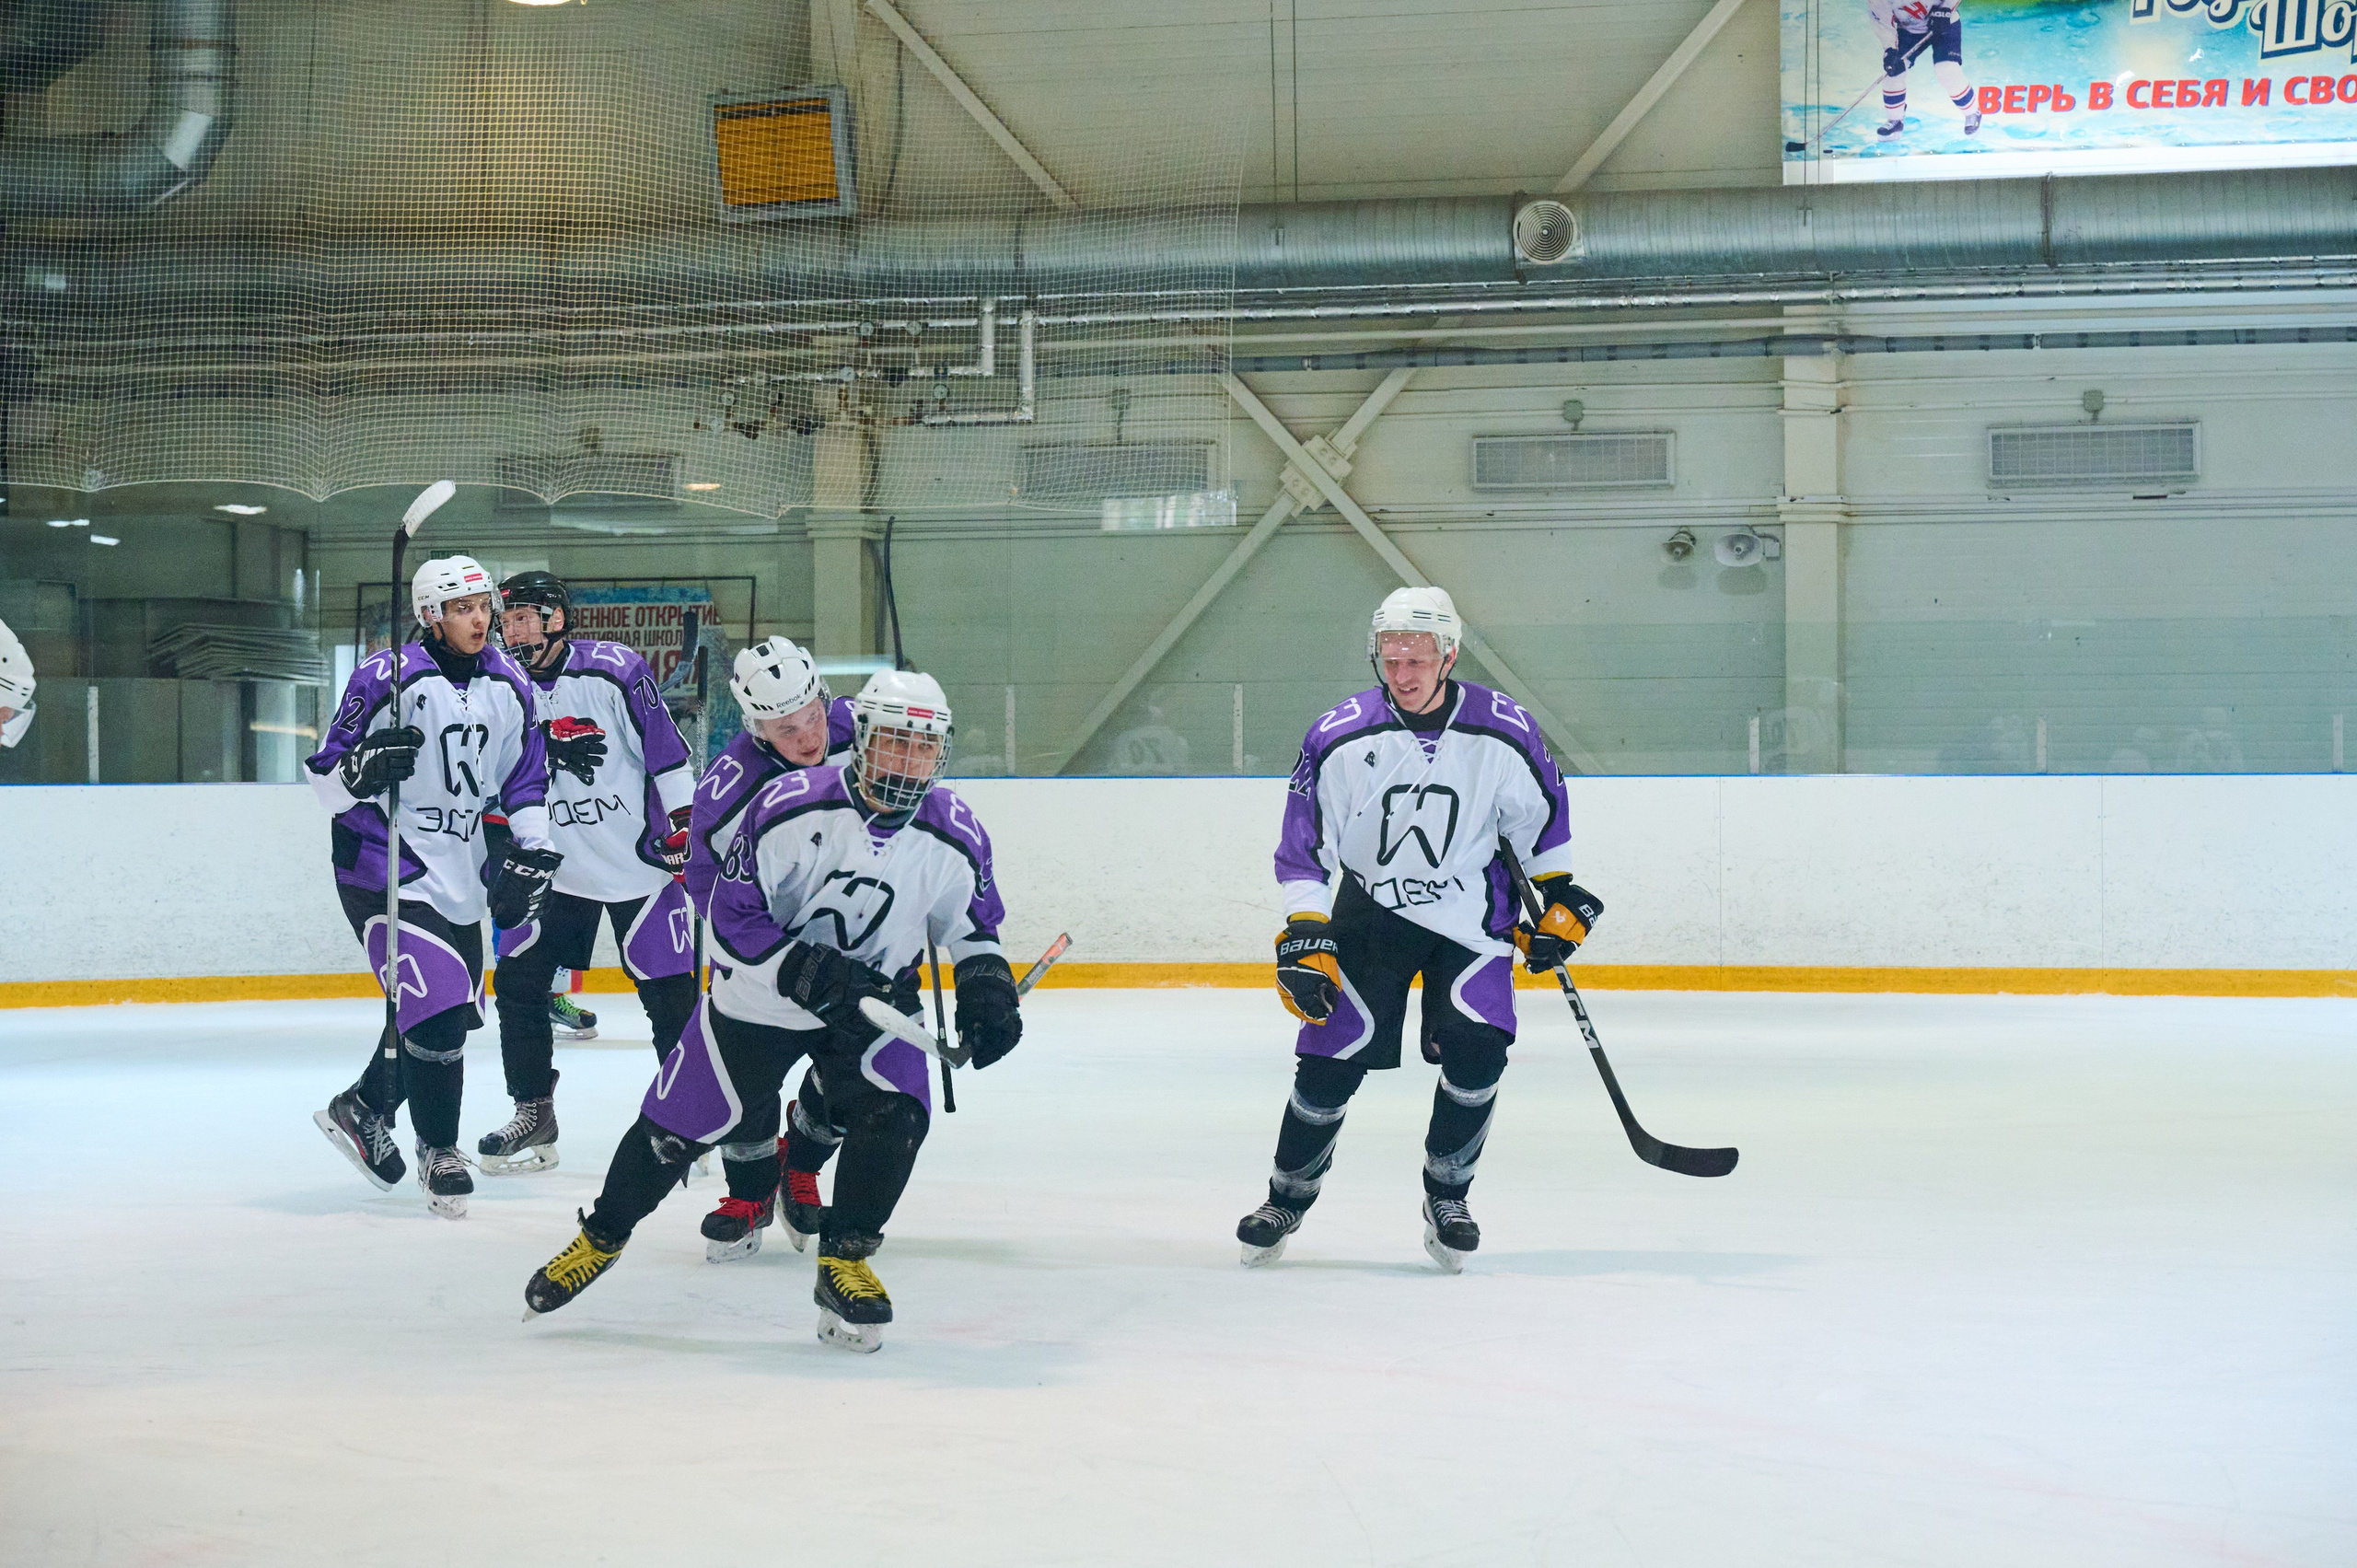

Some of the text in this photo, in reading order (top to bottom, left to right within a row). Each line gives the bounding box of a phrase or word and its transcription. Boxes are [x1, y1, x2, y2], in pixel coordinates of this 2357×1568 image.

[2249, 0, 2357, 64] Шо
[1979, 84, 2076, 115] ВЕРЬ
[2087, 81, 2114, 110] В
[2126, 78, 2229, 109] СЕБЯ
[2240, 77, 2270, 107] И
[565, 629, 684, 647] ПОРТИВНАЯ ШКОЛ
[775, 693, 802, 709] Reebok
[549, 794, 632, 827] ДЕМ
[504, 858, 556, 881] CCM
